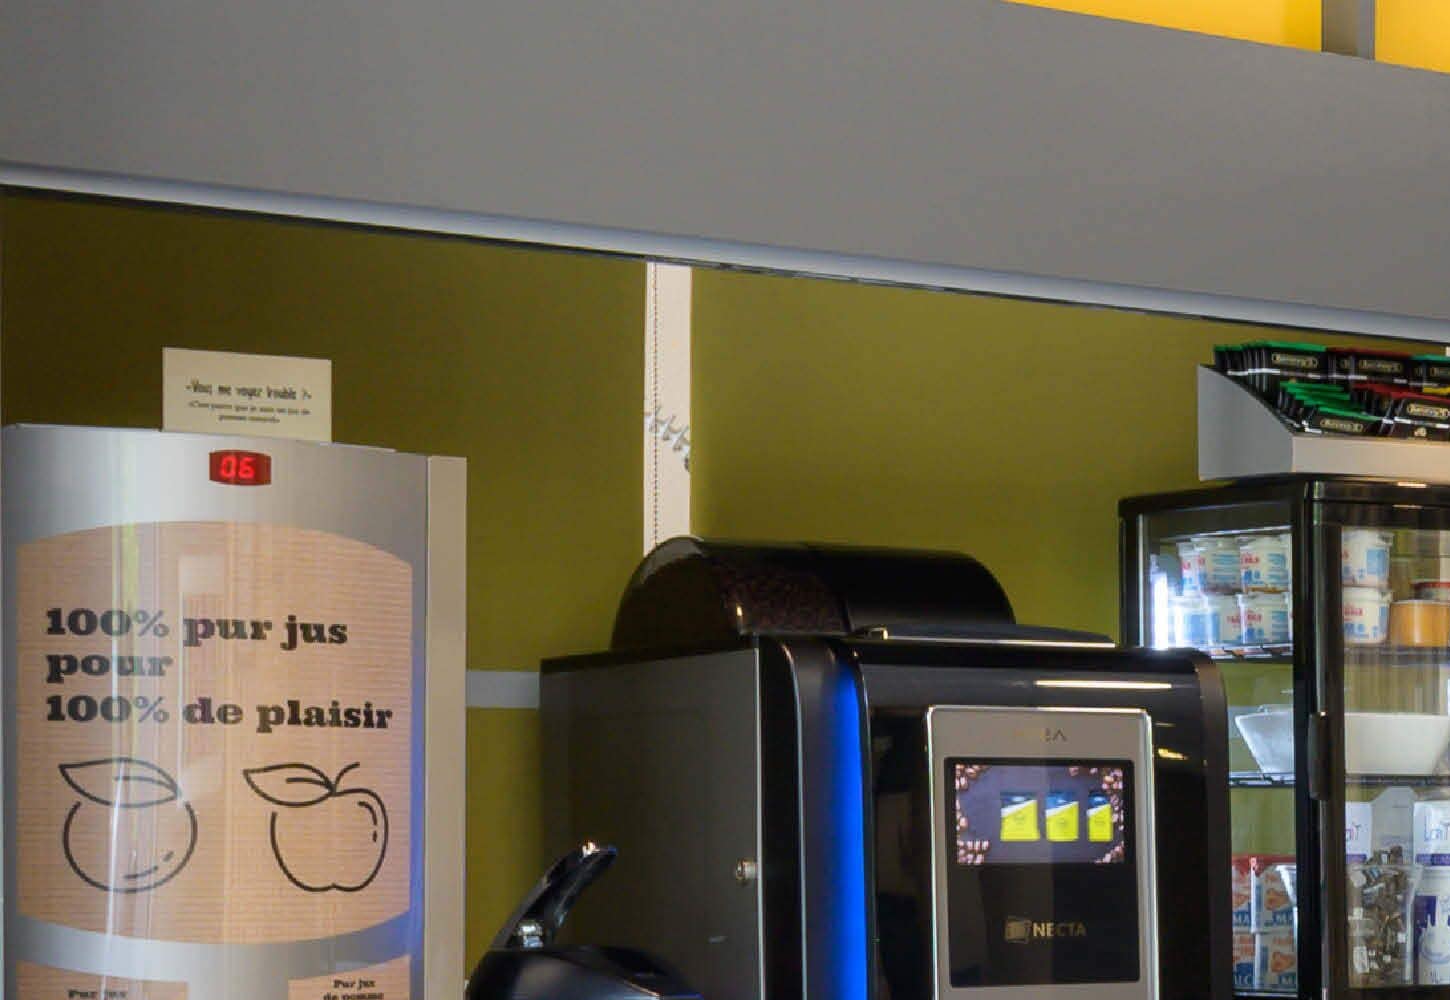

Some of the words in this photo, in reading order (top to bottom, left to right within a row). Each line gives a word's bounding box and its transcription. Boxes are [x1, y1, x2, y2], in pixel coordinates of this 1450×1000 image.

[46, 608, 169, 637] 100%
[183, 618, 272, 647] pur
[279, 614, 348, 651] jus
[46, 654, 174, 684] pour
[46, 695, 169, 723] 100%
[183, 697, 243, 724] de
[255, 699, 393, 734] plaisir
[1033, 923, 1086, 937] NECTA
[333, 979, 356, 988] Pur
[323, 992, 338, 1000] de
